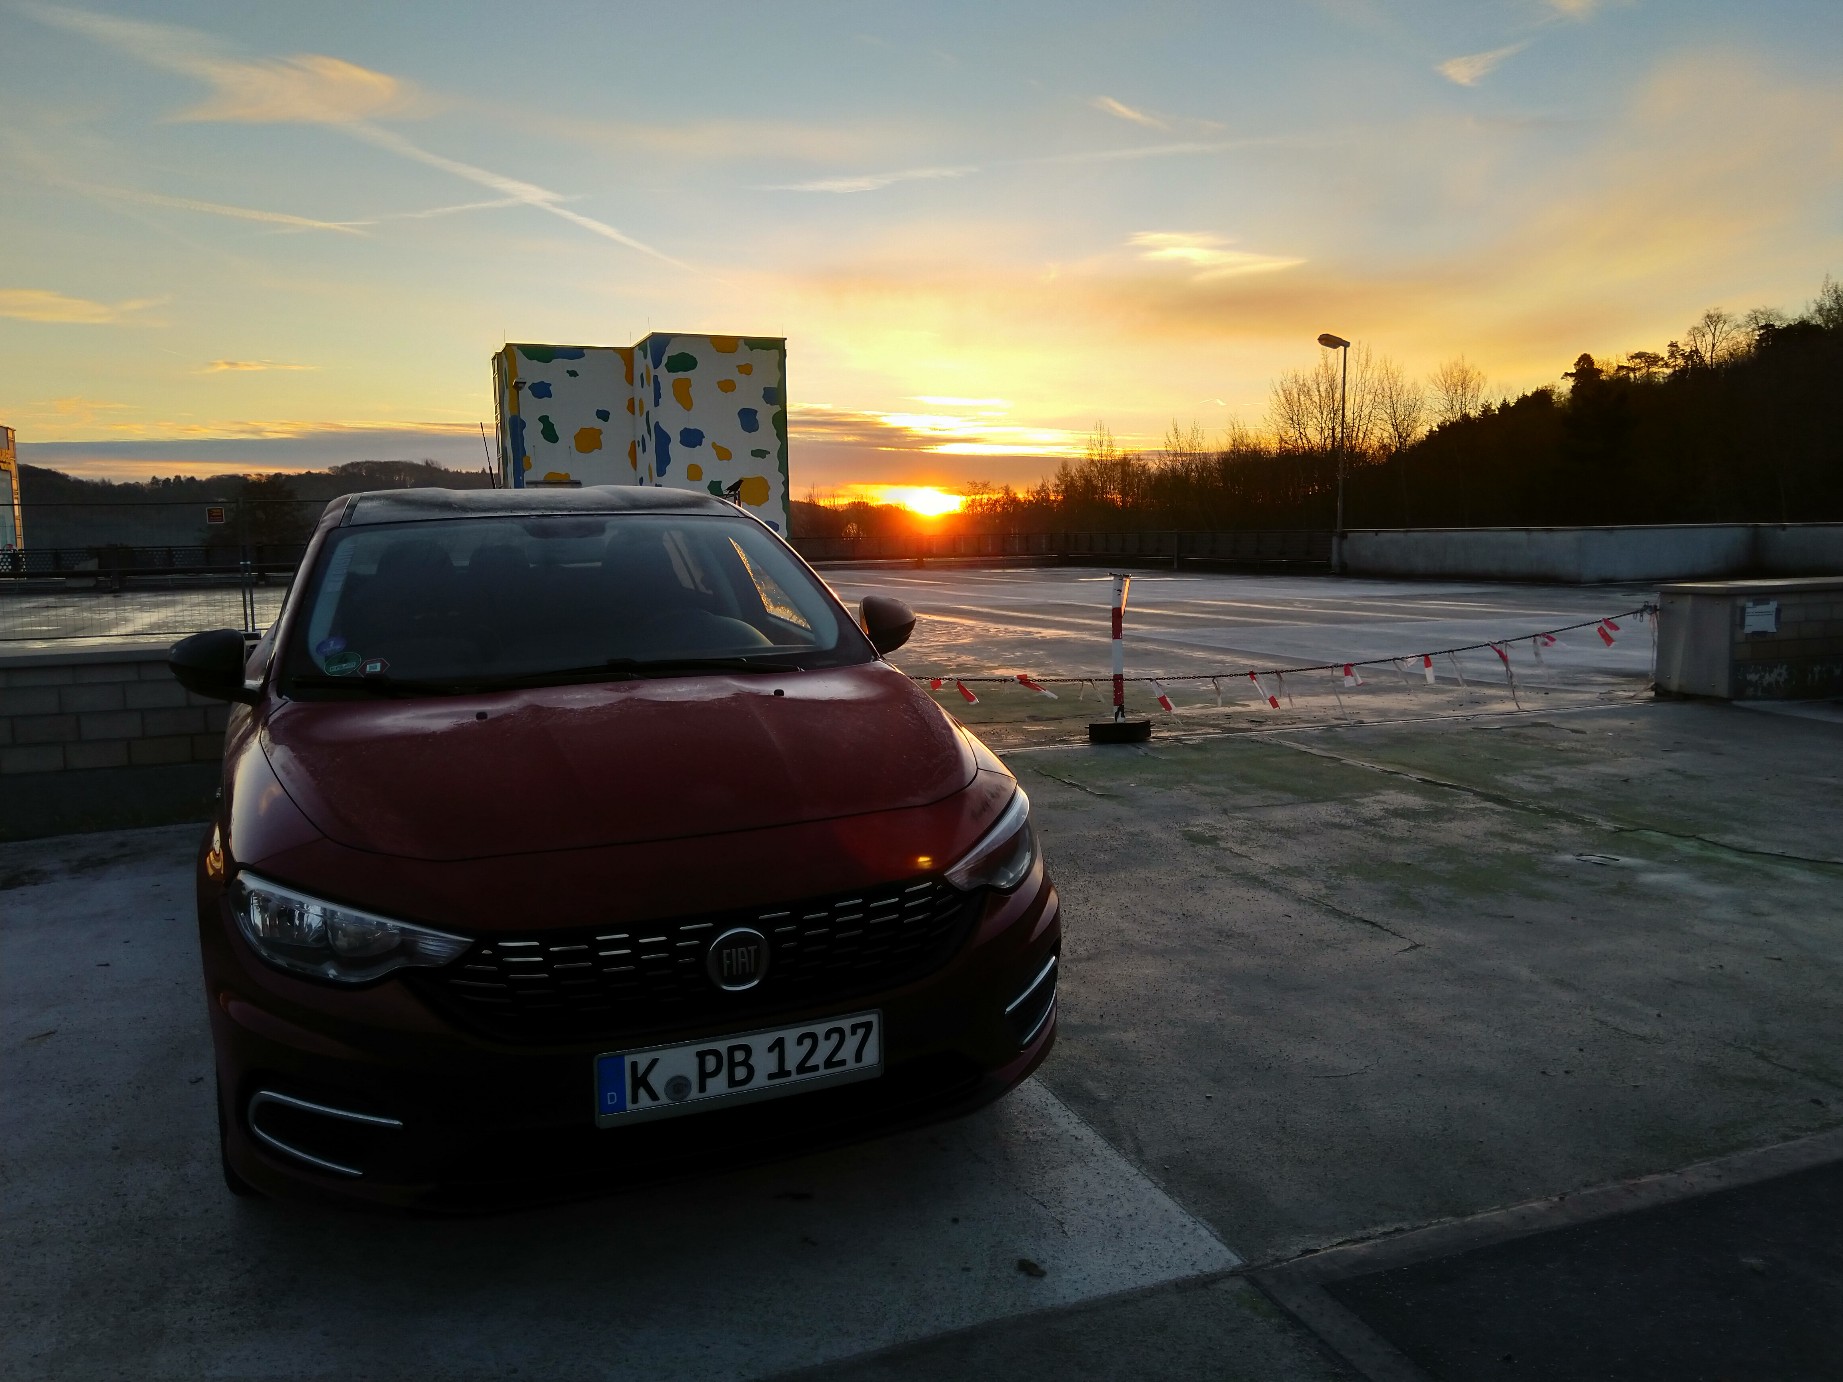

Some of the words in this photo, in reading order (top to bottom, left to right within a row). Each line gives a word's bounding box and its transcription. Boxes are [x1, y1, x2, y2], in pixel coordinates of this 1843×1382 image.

[722, 945, 758, 977] FIAT
[630, 1057, 661, 1105] K
[695, 1043, 755, 1093] PB
[767, 1020, 874, 1081] 1227
[606, 1092, 618, 1105] D
